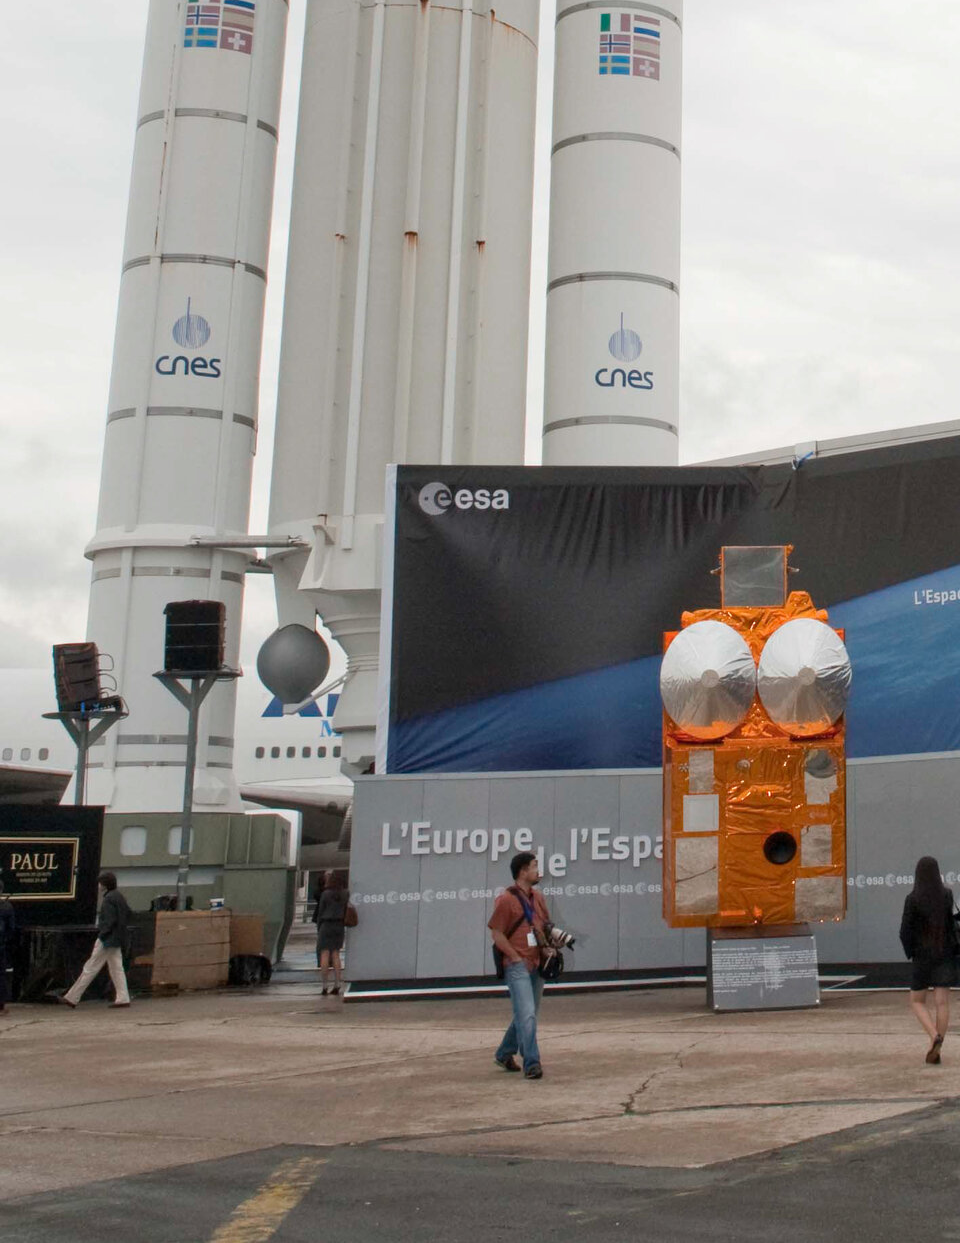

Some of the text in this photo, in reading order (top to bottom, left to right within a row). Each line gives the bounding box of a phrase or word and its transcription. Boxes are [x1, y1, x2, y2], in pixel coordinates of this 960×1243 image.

[155, 355, 221, 378] cnes
[595, 368, 653, 390] cnes
[455, 488, 510, 509] esa
[381, 821, 533, 862] L'Europe
[10, 853, 59, 870] PAUL
[647, 883, 662, 893] es
